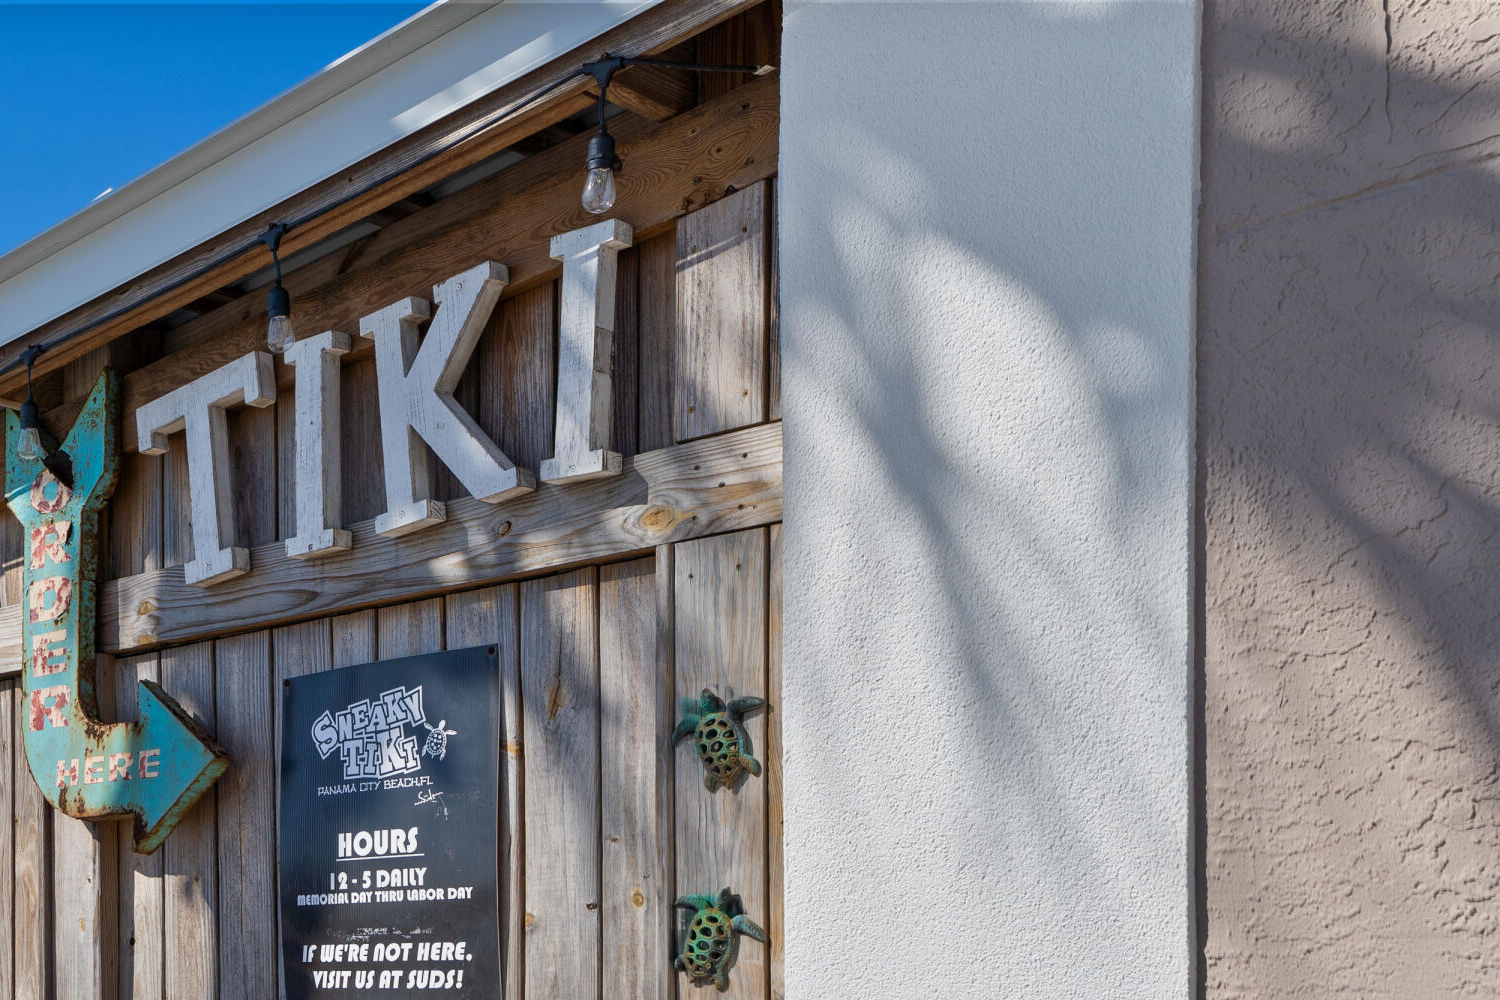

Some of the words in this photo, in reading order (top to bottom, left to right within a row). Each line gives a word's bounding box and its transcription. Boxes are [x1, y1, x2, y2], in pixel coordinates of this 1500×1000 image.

[136, 218, 633, 588] TIKI
[29, 468, 72, 732] ORDER
[312, 685, 426, 760] SNEAKY
[341, 724, 421, 779] TIKI
[56, 748, 161, 788] HERE
[317, 783, 357, 797] PANAMA
[359, 780, 380, 792] CITY
[337, 826, 419, 857] HOURS
[329, 871, 348, 890] 12
[362, 870, 372, 889] 5
[376, 867, 428, 888] DAILY
[297, 892, 349, 906] MEMORIAL
[350, 891, 374, 904] DAY
[375, 890, 404, 903] THRU
[406, 888, 444, 902] LABOR
[447, 886, 474, 900] DAY
[302, 945, 318, 963] IF
[319, 943, 369, 963] WE'RE
[373, 942, 413, 963] NOT
[312, 970, 351, 989] VISIT
[354, 969, 375, 989] US
[378, 969, 404, 989] AT
[406, 969, 464, 989] SUDS!
